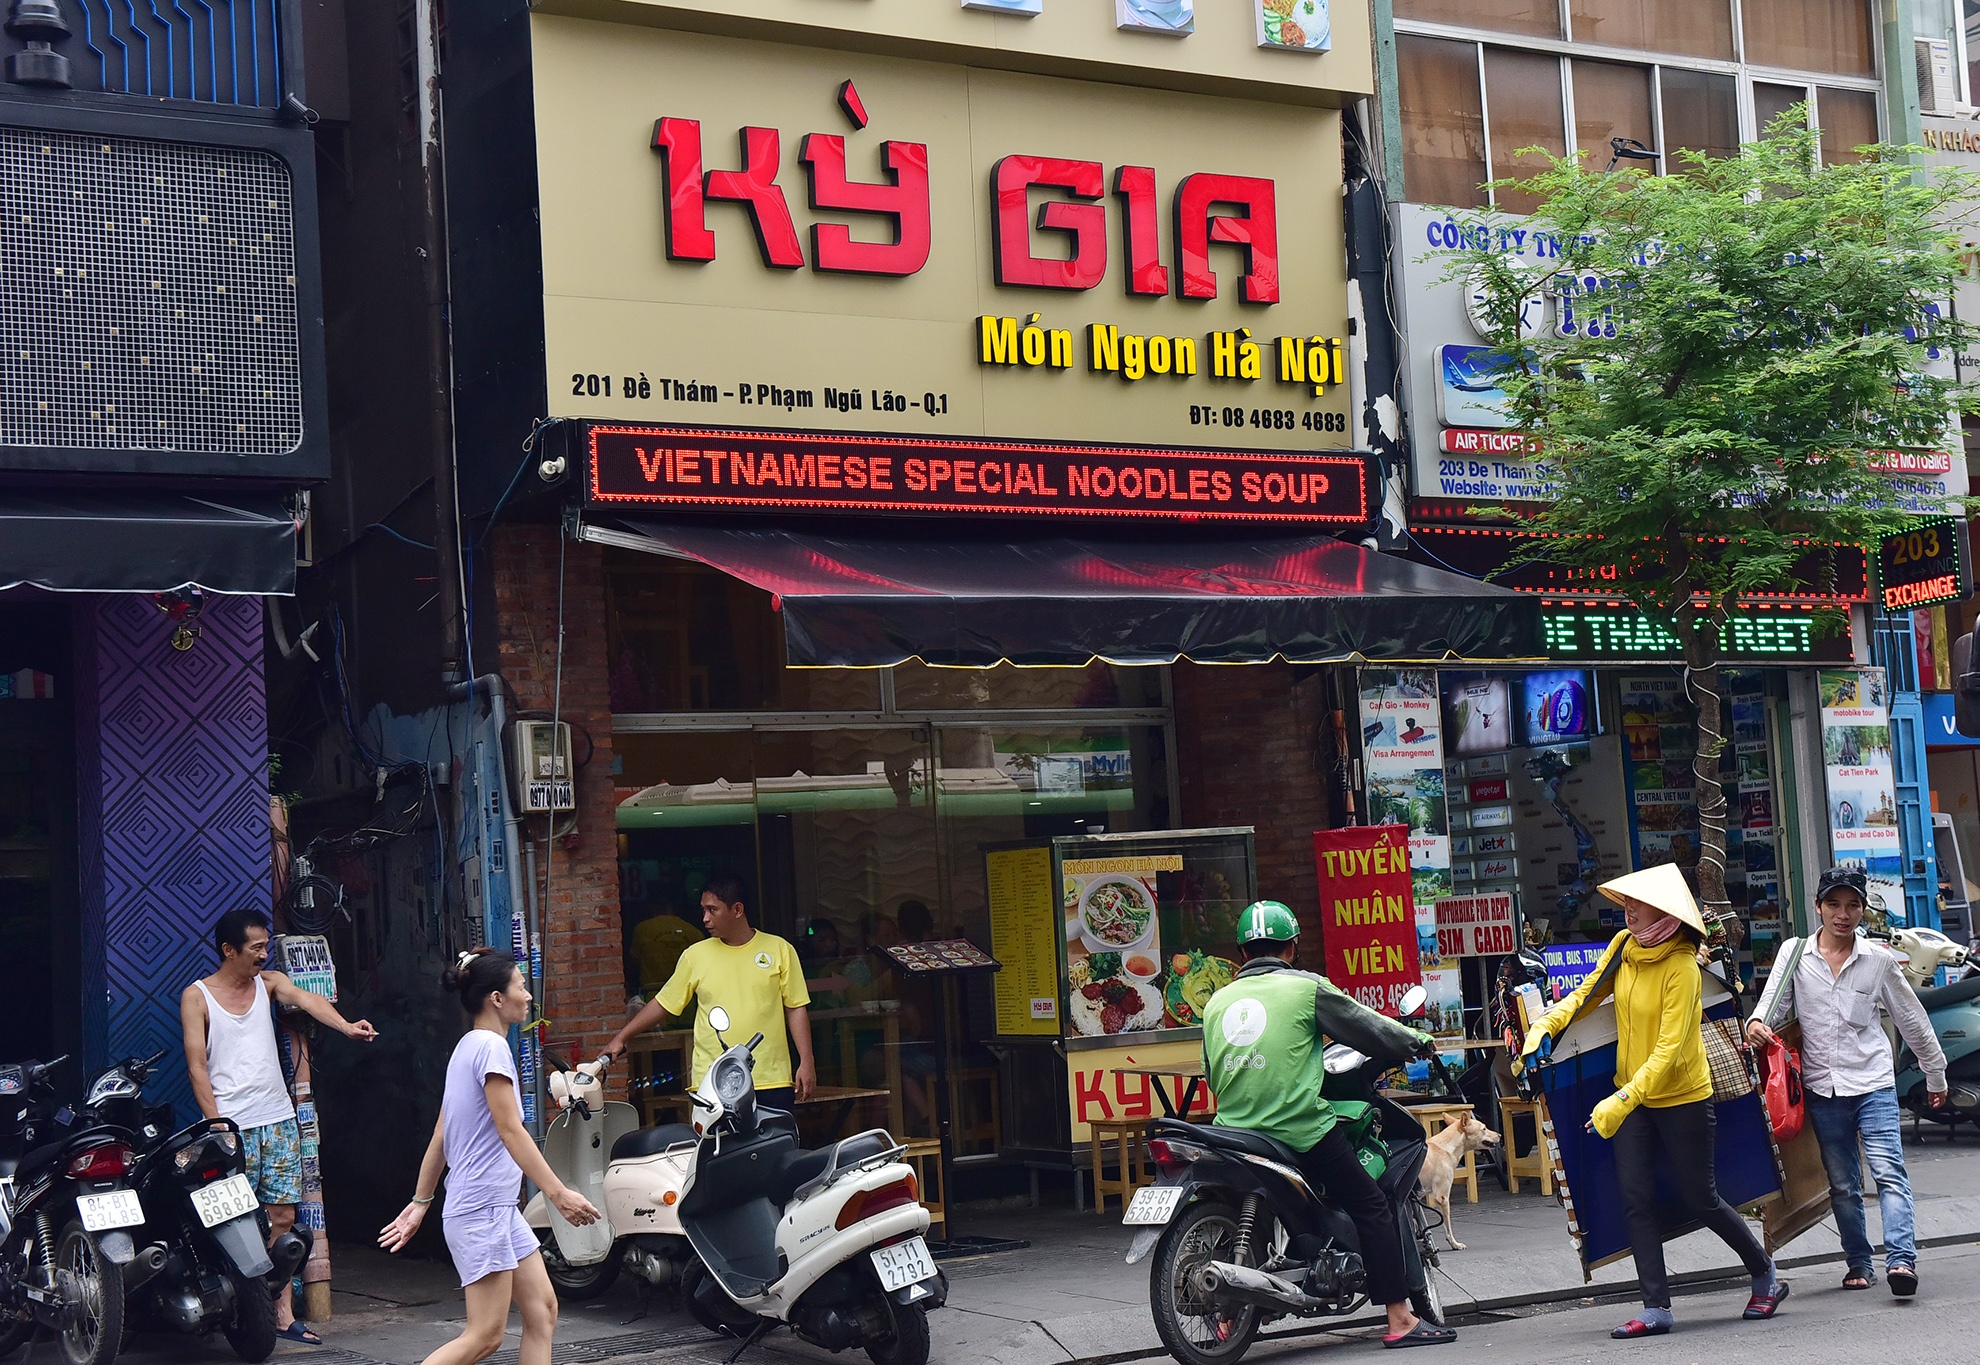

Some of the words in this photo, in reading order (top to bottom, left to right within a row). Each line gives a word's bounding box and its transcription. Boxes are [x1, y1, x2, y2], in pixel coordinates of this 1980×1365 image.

[650, 78, 932, 276] KỲ
[990, 153, 1281, 306] GIA
[977, 312, 1073, 369] Món
[1087, 323, 1197, 382] Ngon
[1208, 326, 1261, 381] Hà
[1275, 336, 1344, 398] Nội
[571, 373, 611, 397] 201
[623, 371, 651, 399] Đề
[825, 387, 863, 413] Ngũ
[1189, 404, 1218, 426] ĐT:
[1223, 406, 1245, 428] 08
[1249, 408, 1295, 431] 4683
[1302, 411, 1346, 433] 4683
[1454, 432, 1478, 449] AIR
[1439, 459, 1465, 476] 203
[1899, 453, 1949, 470] MOTOBIKE
[636, 446, 893, 491] VIETNAMESE
[903, 458, 1057, 498] SPECIAL
[1067, 466, 1232, 503] NOODLES
[1241, 471, 1330, 505] SOUP
[1440, 478, 1502, 496] Website:
[1892, 528, 1940, 565] 203
[1884, 574, 1958, 608] EXCHANGE
[1630, 681, 1651, 691] NORTH
[1652, 681, 1664, 691] VIET
[1664, 681, 1678, 691] NAM
[1369, 701, 1384, 710] Can
[1385, 701, 1398, 709] Gio
[1403, 701, 1430, 710] Monkey
[1833, 709, 1861, 717] motobike
[1373, 750, 1389, 758] Visa
[1390, 749, 1435, 758] Arrangement
[1737, 744, 1755, 752] Airlines
[1838, 769, 1850, 777] Cat
[1851, 769, 1864, 777] Tien
[1865, 769, 1879, 777] Park
[530, 787, 571, 808] 0977.00.040
[1636, 792, 1663, 802] CENTRAL
[1663, 792, 1676, 801] VIET
[1677, 791, 1690, 801] NAM
[1421, 838, 1436, 847] tour
[1836, 831, 1845, 839] Cu
[1859, 830, 1871, 838] and
[1872, 830, 1884, 838] Cao
[1885, 829, 1896, 838] Dai
[1063, 858, 1095, 875] MÓN
[1096, 858, 1135, 874] NGON
[1136, 856, 1155, 871] HÀ
[1156, 855, 1181, 873] NỘI
[1321, 832, 1407, 878] TUYỂN
[1751, 874, 1766, 882] Open
[1334, 889, 1404, 927] NHÂN
[1436, 900, 1475, 925] MOTORBIKE
[1475, 899, 1489, 922] FOR
[1490, 897, 1510, 921] RENT
[1437, 927, 1465, 957] SIM
[1474, 925, 1514, 954] CARD
[1343, 938, 1404, 976] VIÊN
[1543, 951, 1566, 967] TOUR,
[1566, 950, 1584, 966] BUS,
[1425, 972, 1442, 982] Tour
[1223, 1048, 1266, 1072] Grab
[1074, 1055, 1152, 1123] KỲ
[87, 1194, 128, 1212] 84-B1
[200, 1180, 242, 1206] 59-T1
[1139, 1190, 1172, 1205] 59-G1
[87, 1208, 140, 1229] 534.85
[203, 1194, 255, 1225] 698.82
[1129, 1206, 1171, 1223] 526.02
[879, 1242, 919, 1269] 51-T1
[888, 1260, 930, 1288] 2792
